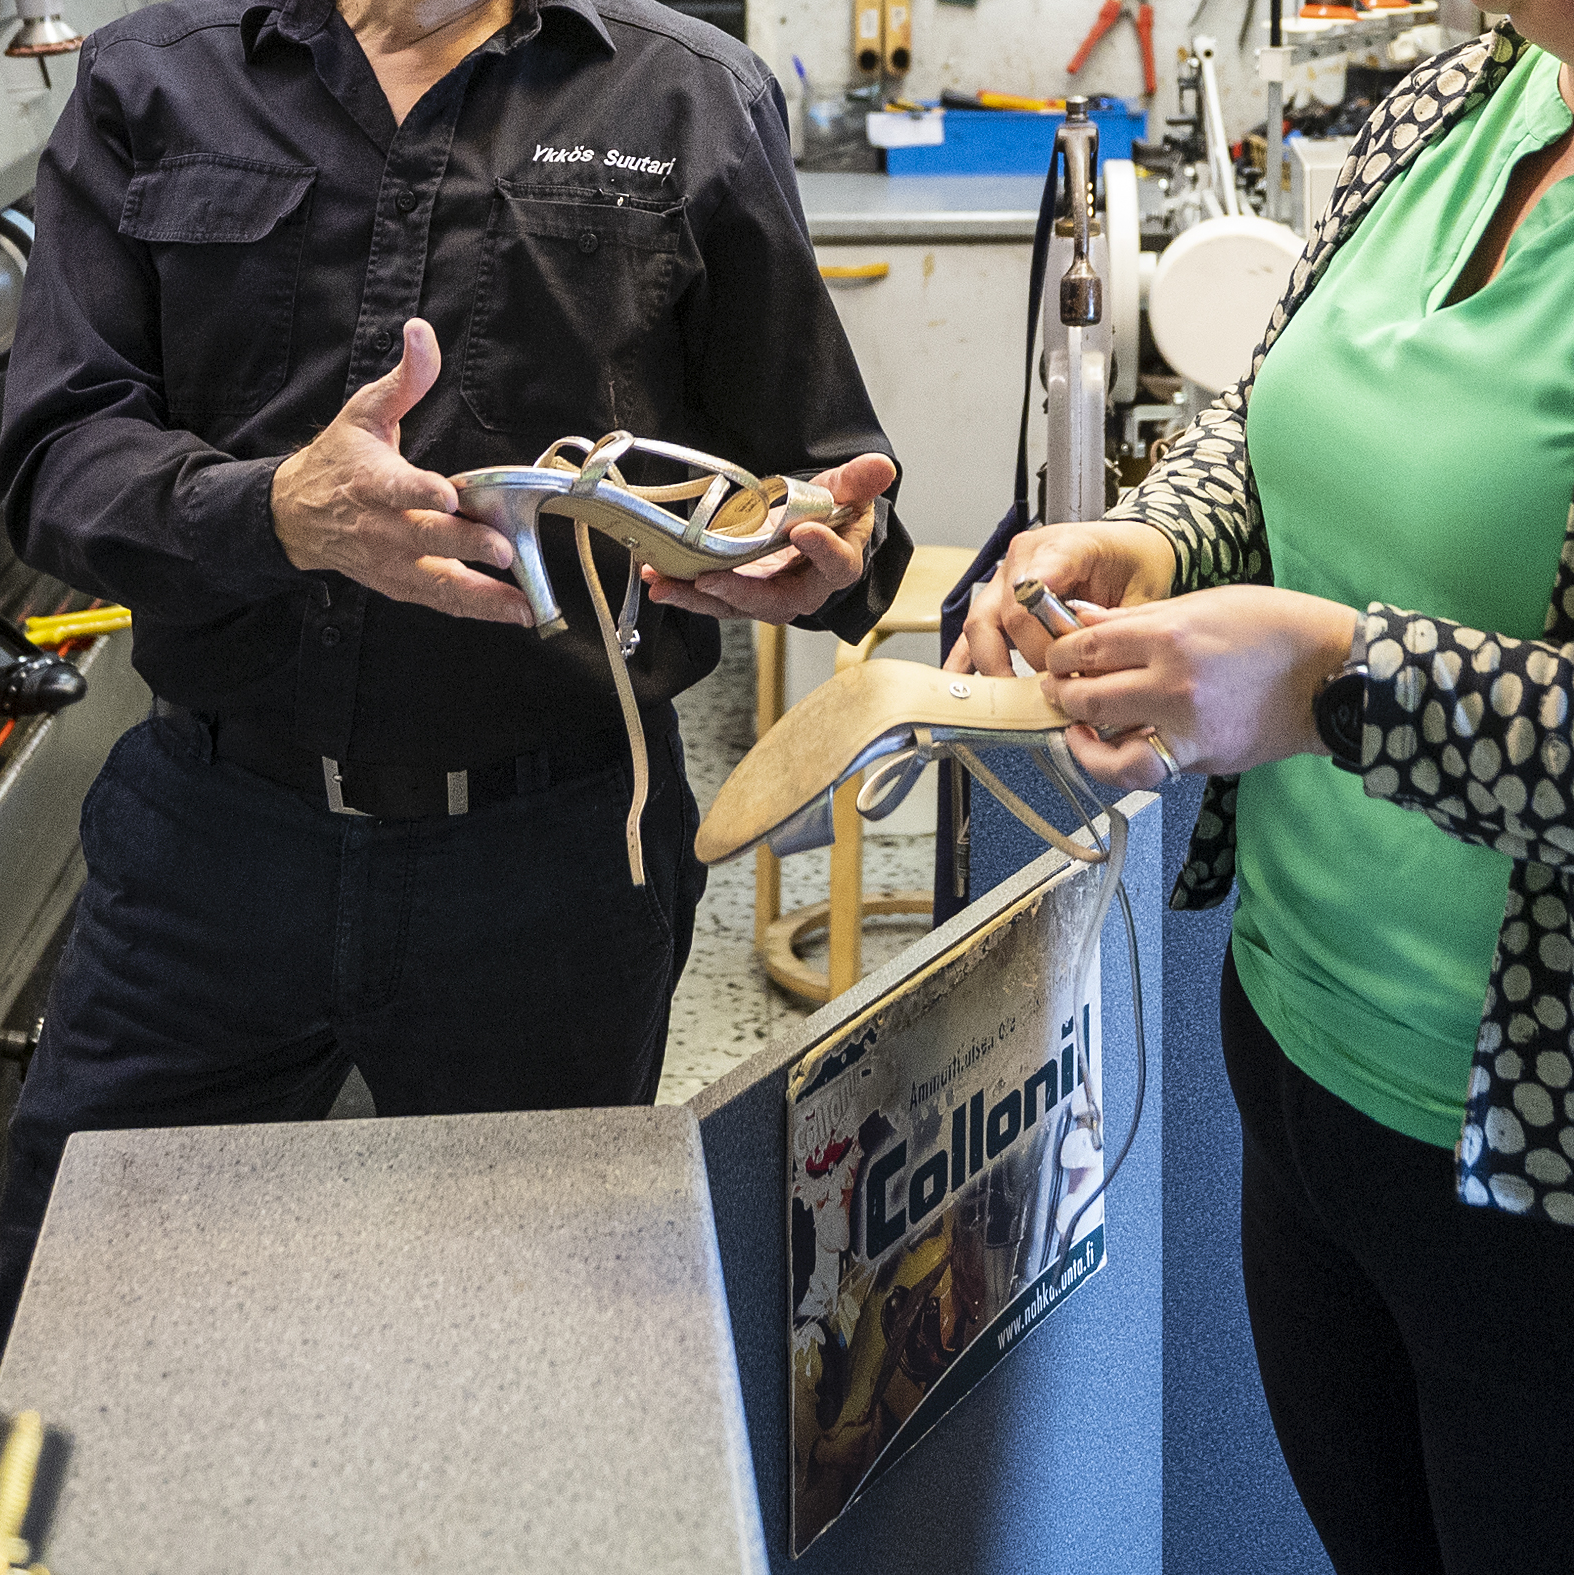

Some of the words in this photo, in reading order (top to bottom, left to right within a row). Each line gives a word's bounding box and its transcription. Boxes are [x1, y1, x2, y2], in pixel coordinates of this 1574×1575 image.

[532, 144, 594, 163] Ykkös
[603, 149, 676, 175] Suutari
[866, 1003, 1090, 1261] Collonil
